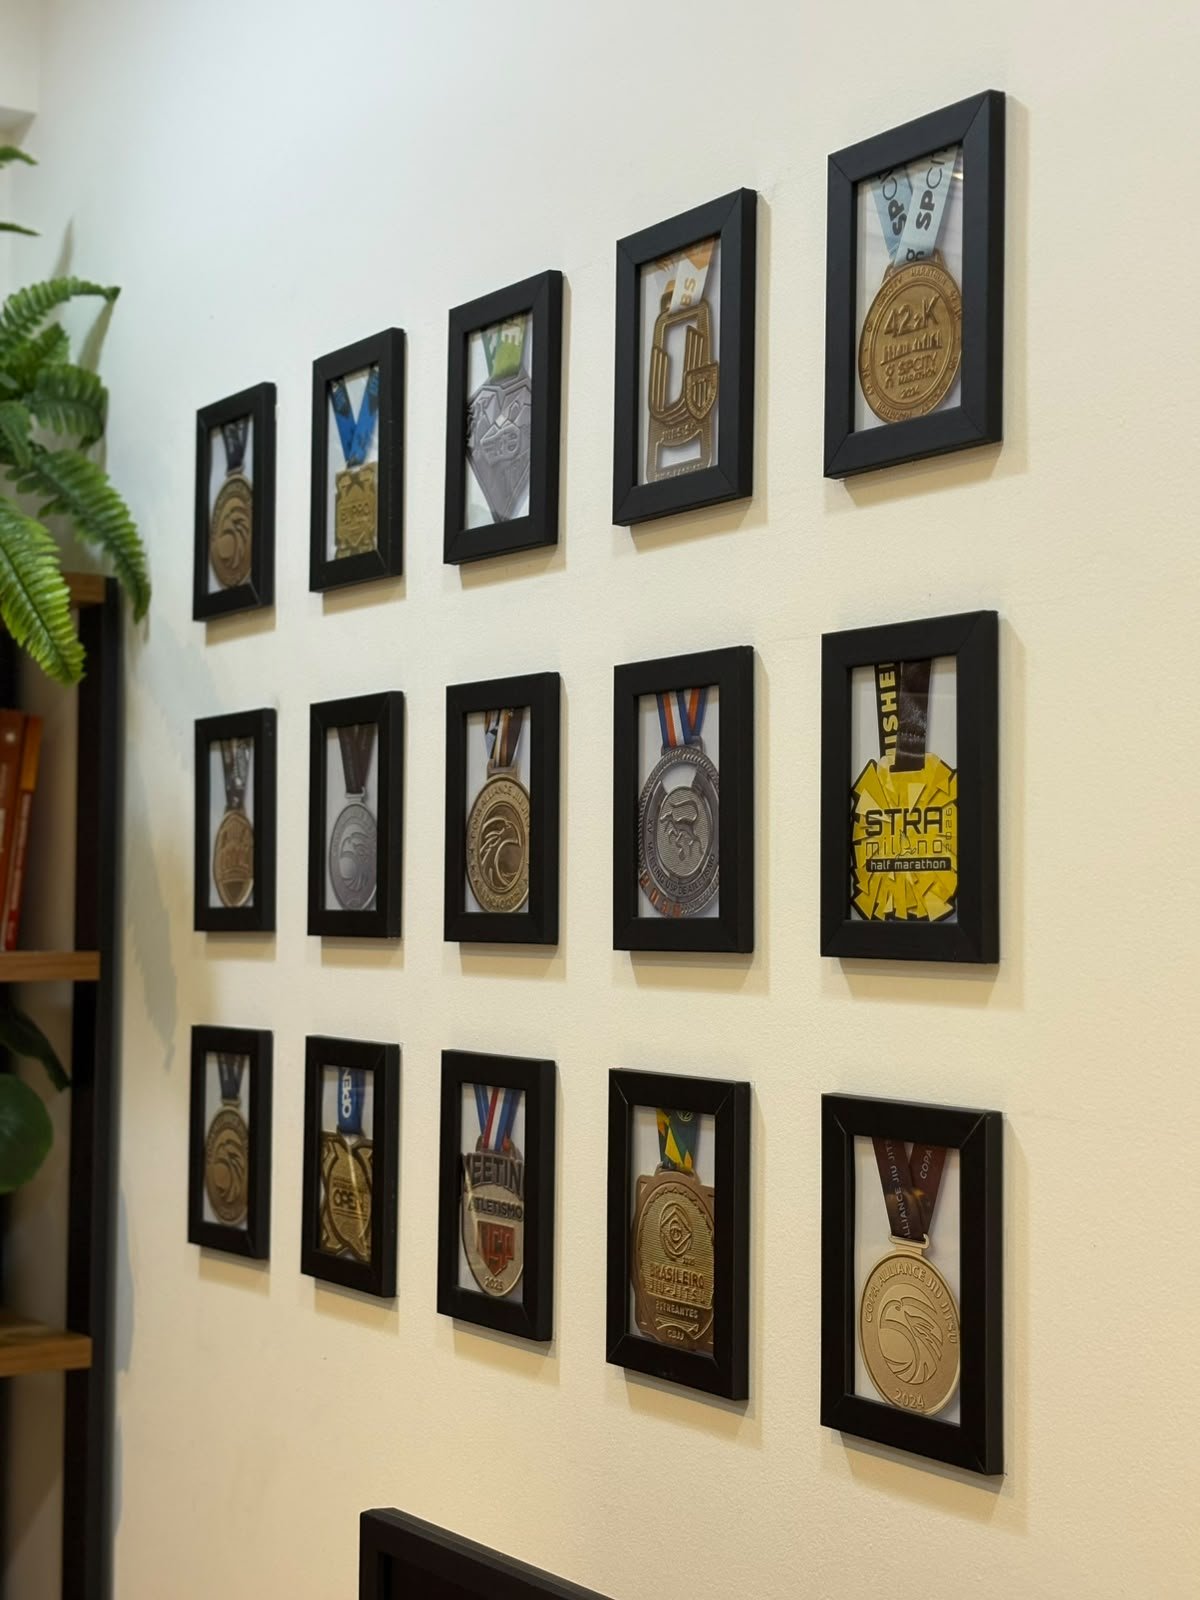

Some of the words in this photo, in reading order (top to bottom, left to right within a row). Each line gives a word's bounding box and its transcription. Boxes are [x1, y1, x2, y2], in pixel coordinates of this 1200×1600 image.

[865, 806, 943, 837] STRA
[870, 860, 891, 871] half
[899, 859, 946, 870] marathon
[919, 1149, 933, 1179] COPA
[894, 1186, 912, 1238] LLIANCE
[865, 1286, 880, 1323] COPA
[879, 1262, 927, 1285] ALLIANCE
[925, 1277, 943, 1299] JIU
[941, 1302, 958, 1344] JITSU
[895, 1387, 925, 1409] 2024
